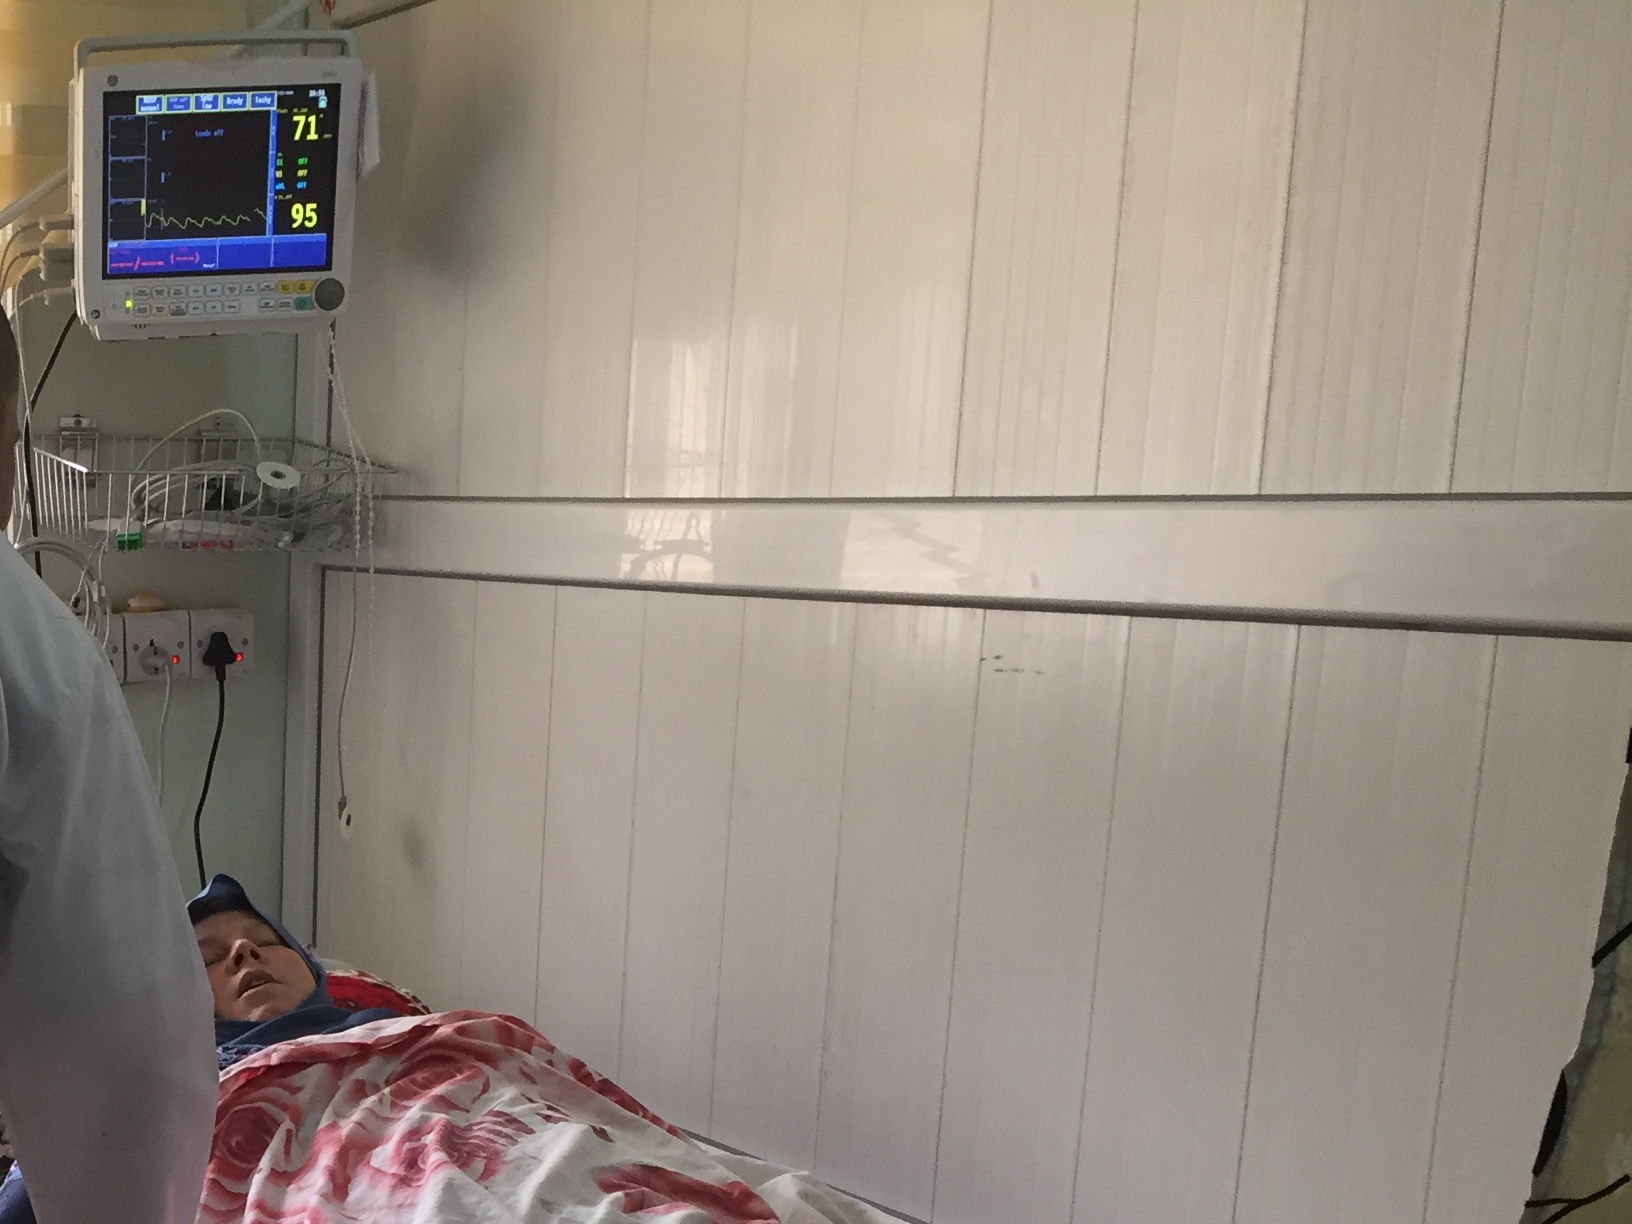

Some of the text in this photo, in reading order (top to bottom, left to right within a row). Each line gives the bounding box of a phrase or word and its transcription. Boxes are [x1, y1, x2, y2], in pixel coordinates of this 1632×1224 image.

[226, 97, 244, 106] Brady
[254, 95, 272, 104] Tachy
[292, 115, 319, 141] 71
[291, 203, 318, 228] 95
